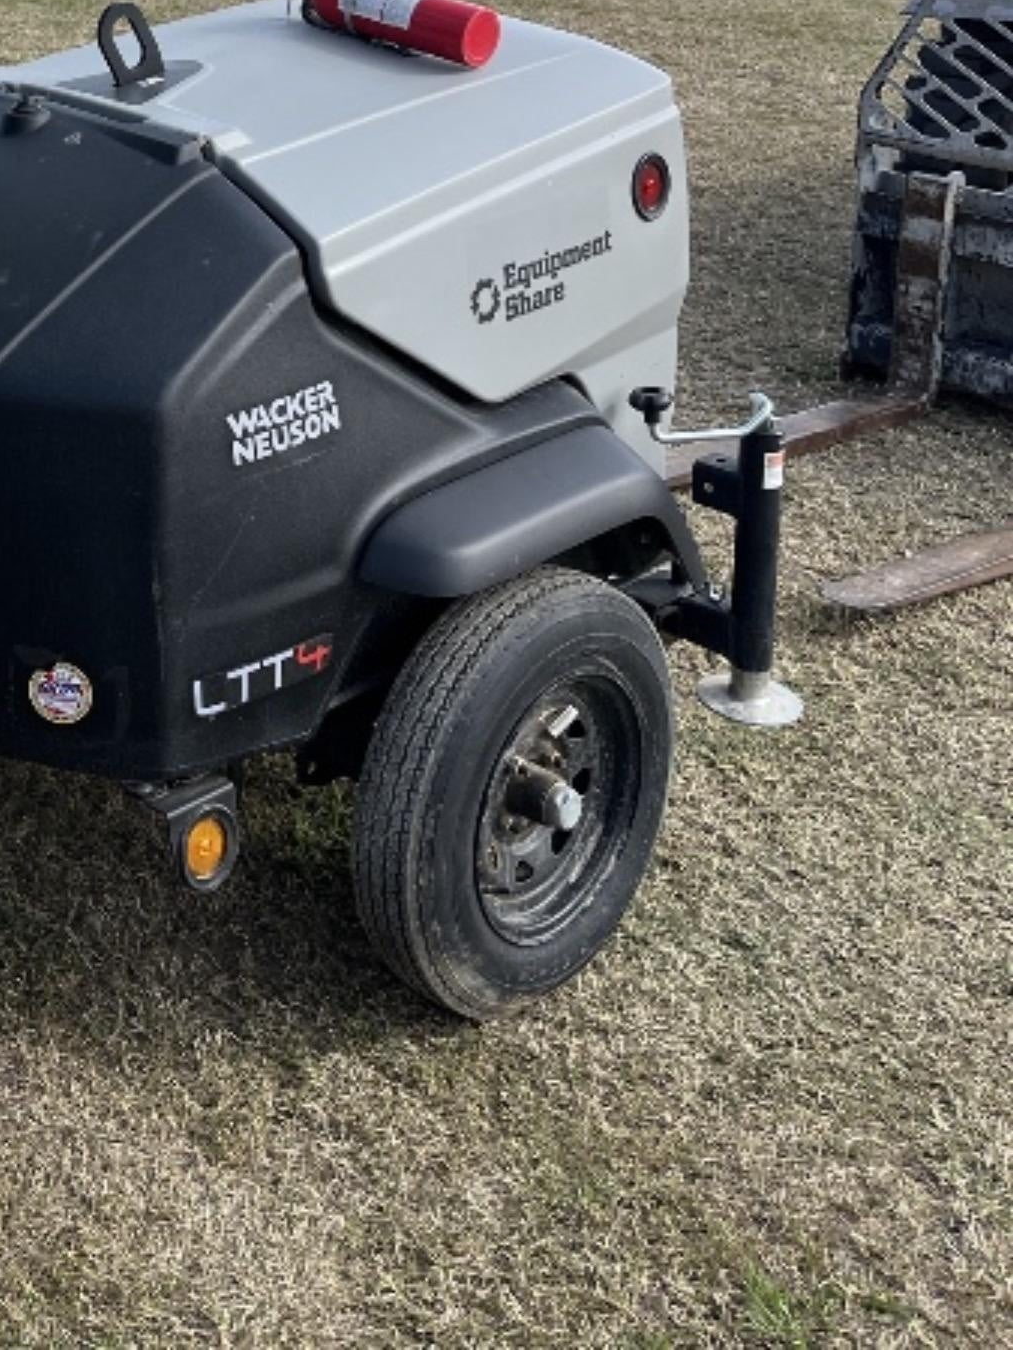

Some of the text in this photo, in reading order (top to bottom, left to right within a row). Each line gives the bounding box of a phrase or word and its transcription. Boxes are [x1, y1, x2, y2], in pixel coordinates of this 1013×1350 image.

[503, 230, 612, 290] Equipment
[505, 282, 565, 321] Share
[227, 380, 336, 439] WACKER
[232, 404, 341, 466] NEUSON
